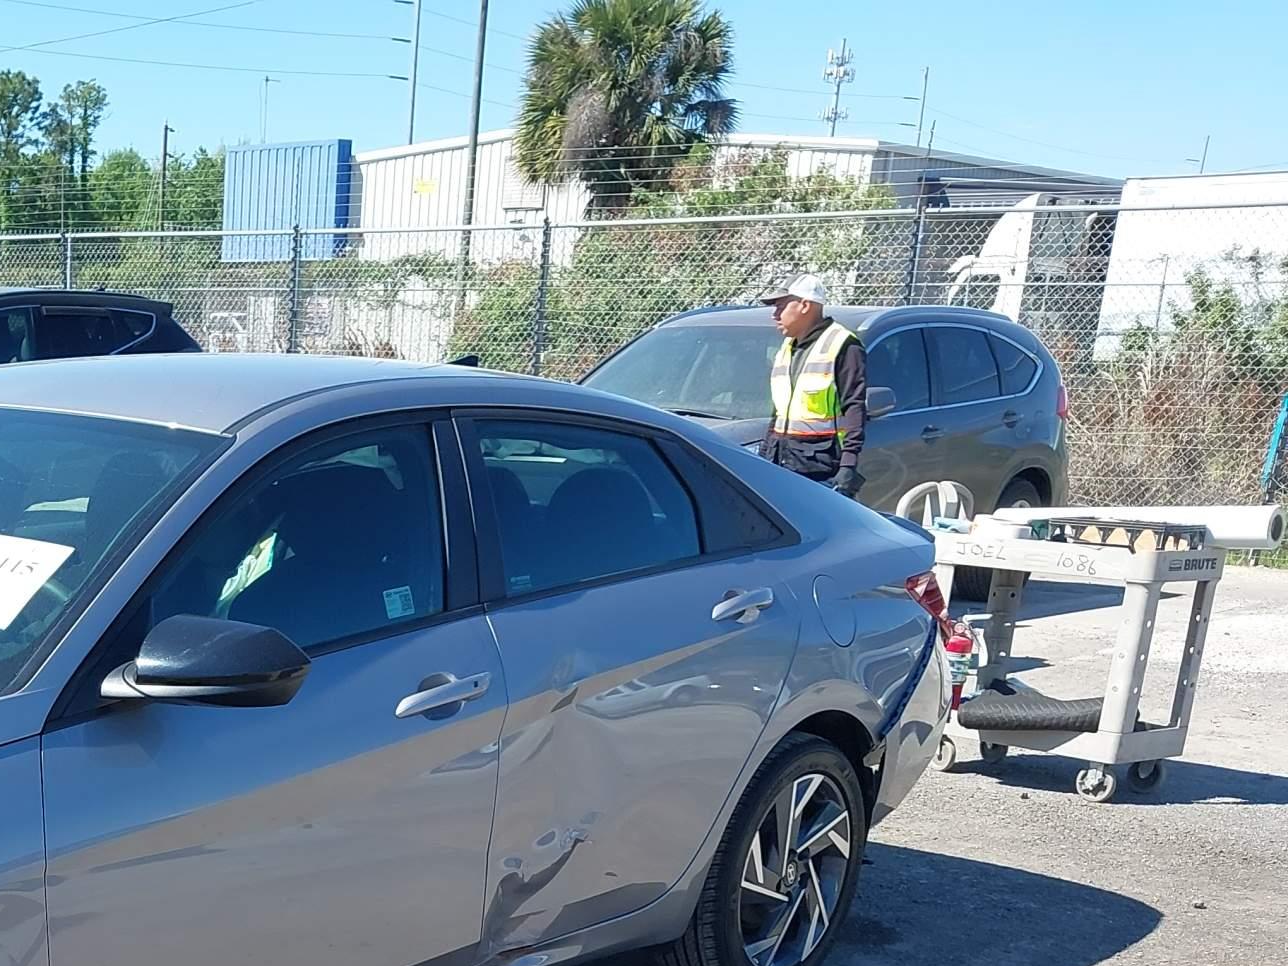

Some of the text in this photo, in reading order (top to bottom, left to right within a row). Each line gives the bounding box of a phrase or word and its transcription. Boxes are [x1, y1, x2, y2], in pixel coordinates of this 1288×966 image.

[956, 541, 1097, 576] JOEL 1086
[1183, 557, 1217, 572] BRUTE
